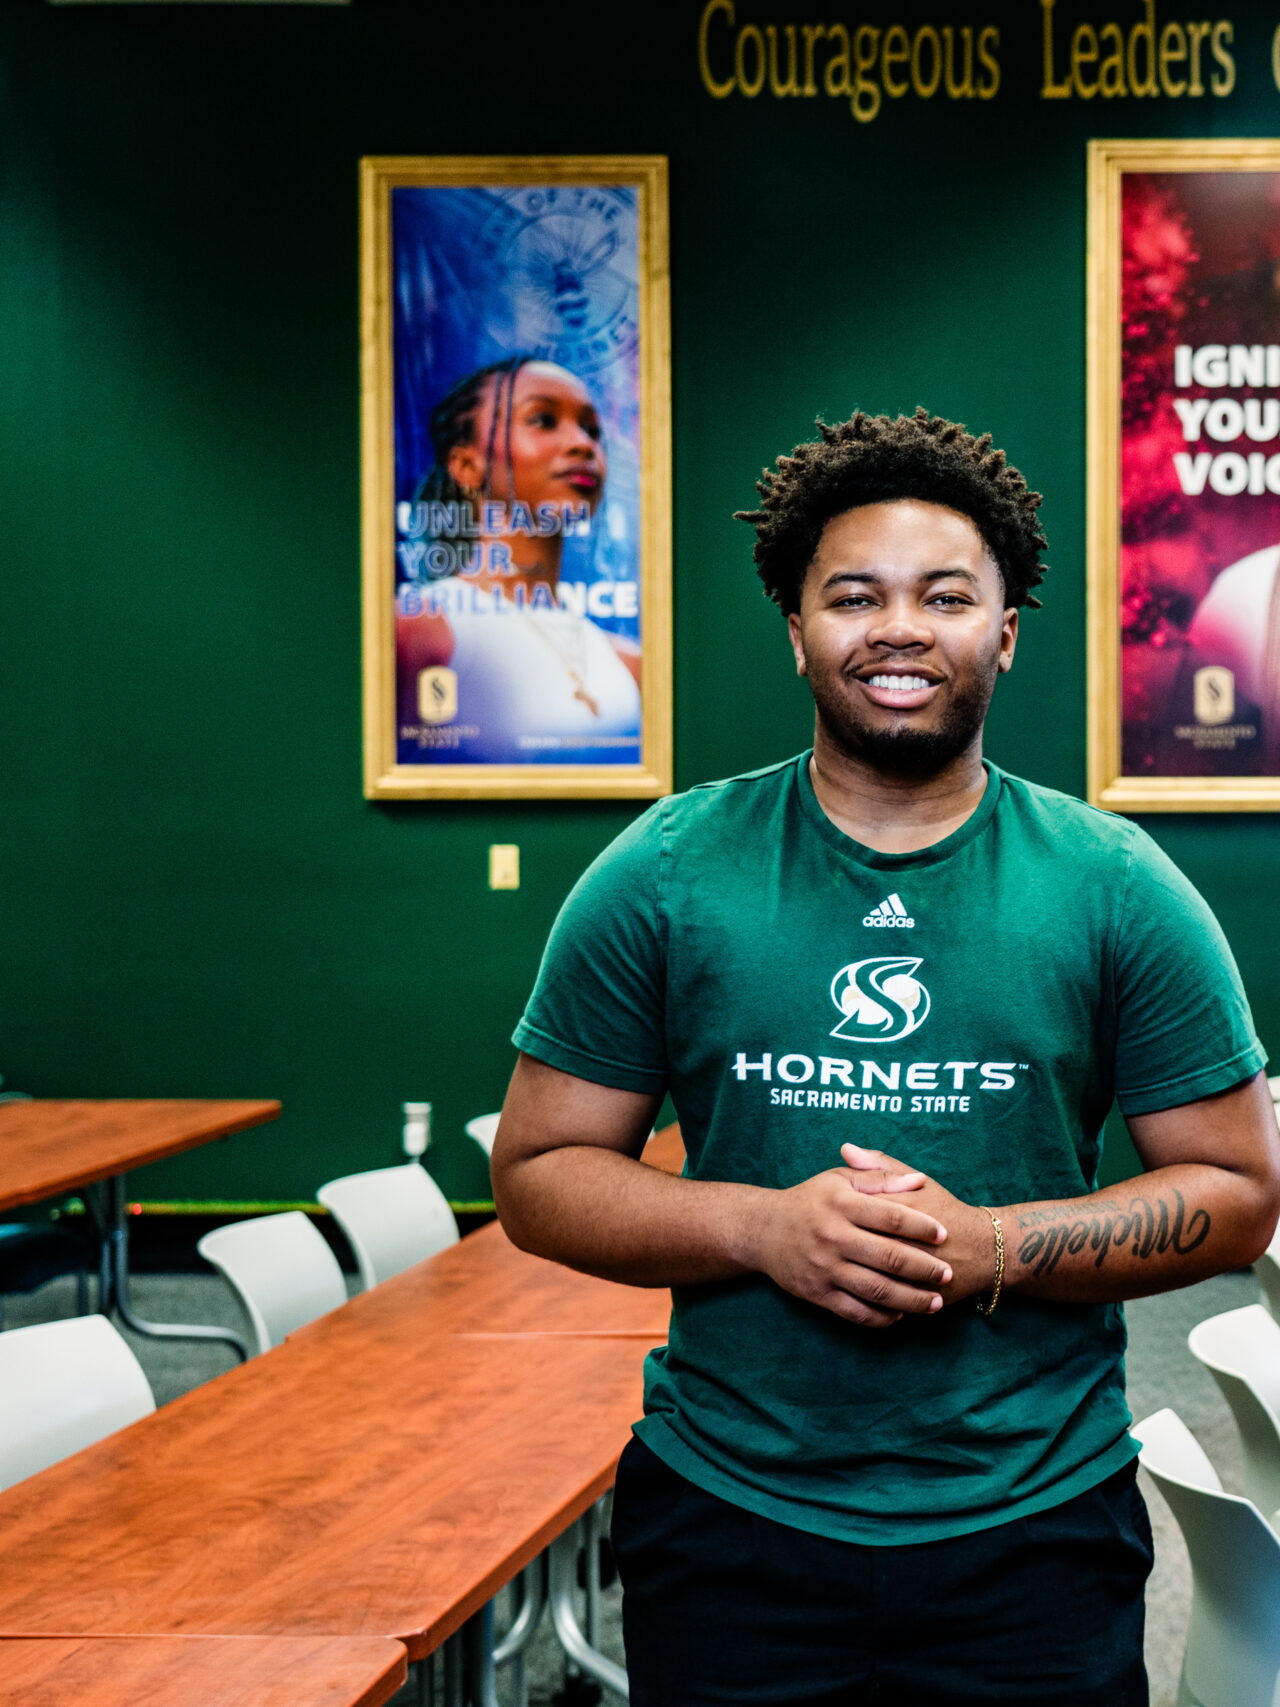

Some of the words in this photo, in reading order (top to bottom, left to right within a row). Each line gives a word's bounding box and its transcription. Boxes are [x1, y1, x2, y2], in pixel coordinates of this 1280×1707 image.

[700, 0, 1000, 123] Courageous
[1041, 0, 1237, 99] Leaders
[397, 500, 592, 538] UNLEASH
[398, 540, 517, 578] YOUR
[397, 580, 640, 618] BRILLIANCE
[862, 913, 915, 929] adidas
[731, 1052, 1017, 1091] HORNETS
[770, 1087, 902, 1113] SACRAMENTO
[911, 1095, 971, 1113] STATE
[1017, 1188, 1211, 1276] Michelle
